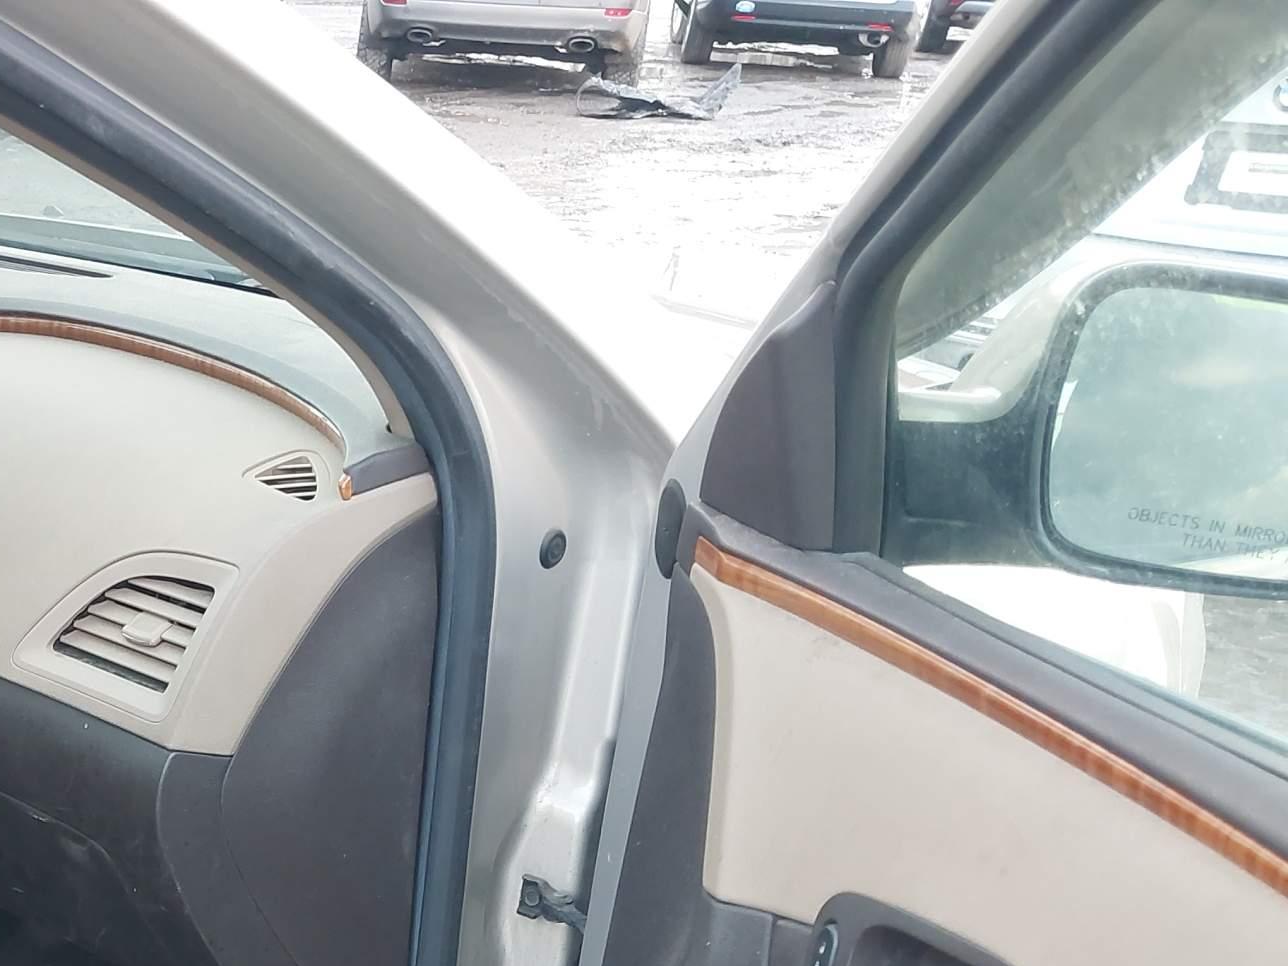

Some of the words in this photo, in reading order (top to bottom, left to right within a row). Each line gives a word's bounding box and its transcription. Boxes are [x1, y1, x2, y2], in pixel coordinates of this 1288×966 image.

[1128, 508, 1200, 530] OBJECTS
[1209, 519, 1226, 533] IN
[1235, 525, 1288, 545] MIRRO
[1183, 532, 1226, 552] THAN
[1237, 543, 1281, 560] THEY
